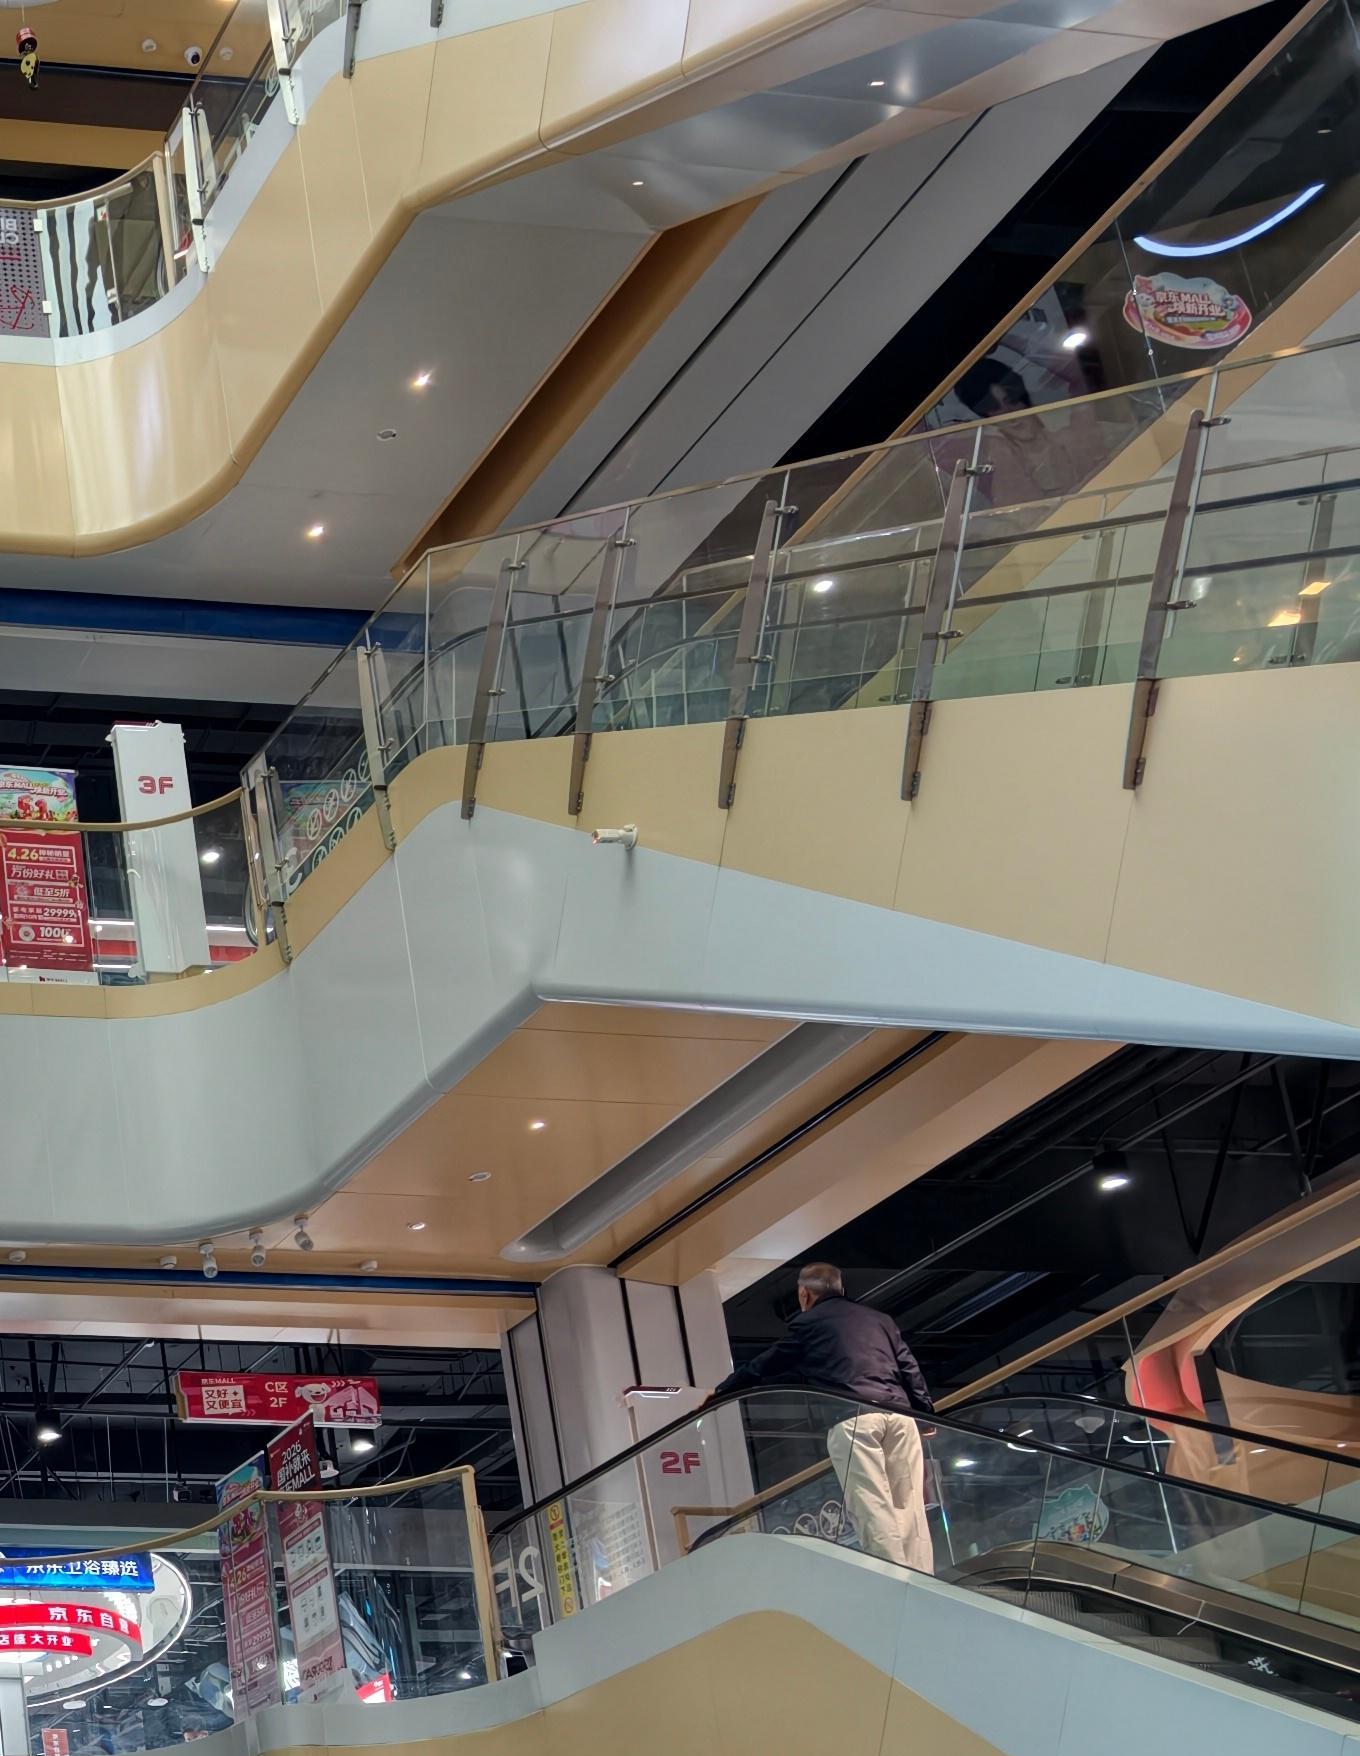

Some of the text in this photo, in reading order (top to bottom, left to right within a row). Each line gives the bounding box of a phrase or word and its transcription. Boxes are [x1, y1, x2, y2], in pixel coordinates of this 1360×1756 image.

[137, 775, 175, 796] 3F
[7, 847, 39, 861] 4.26
[201, 1377, 237, 1385] 京东MALL
[264, 1381, 289, 1393] C区
[204, 1388, 229, 1400] 又好
[205, 1399, 244, 1410] 又便宜
[269, 1397, 288, 1408] 2F
[281, 1441, 302, 1463] 2026
[659, 1451, 701, 1474] 2F
